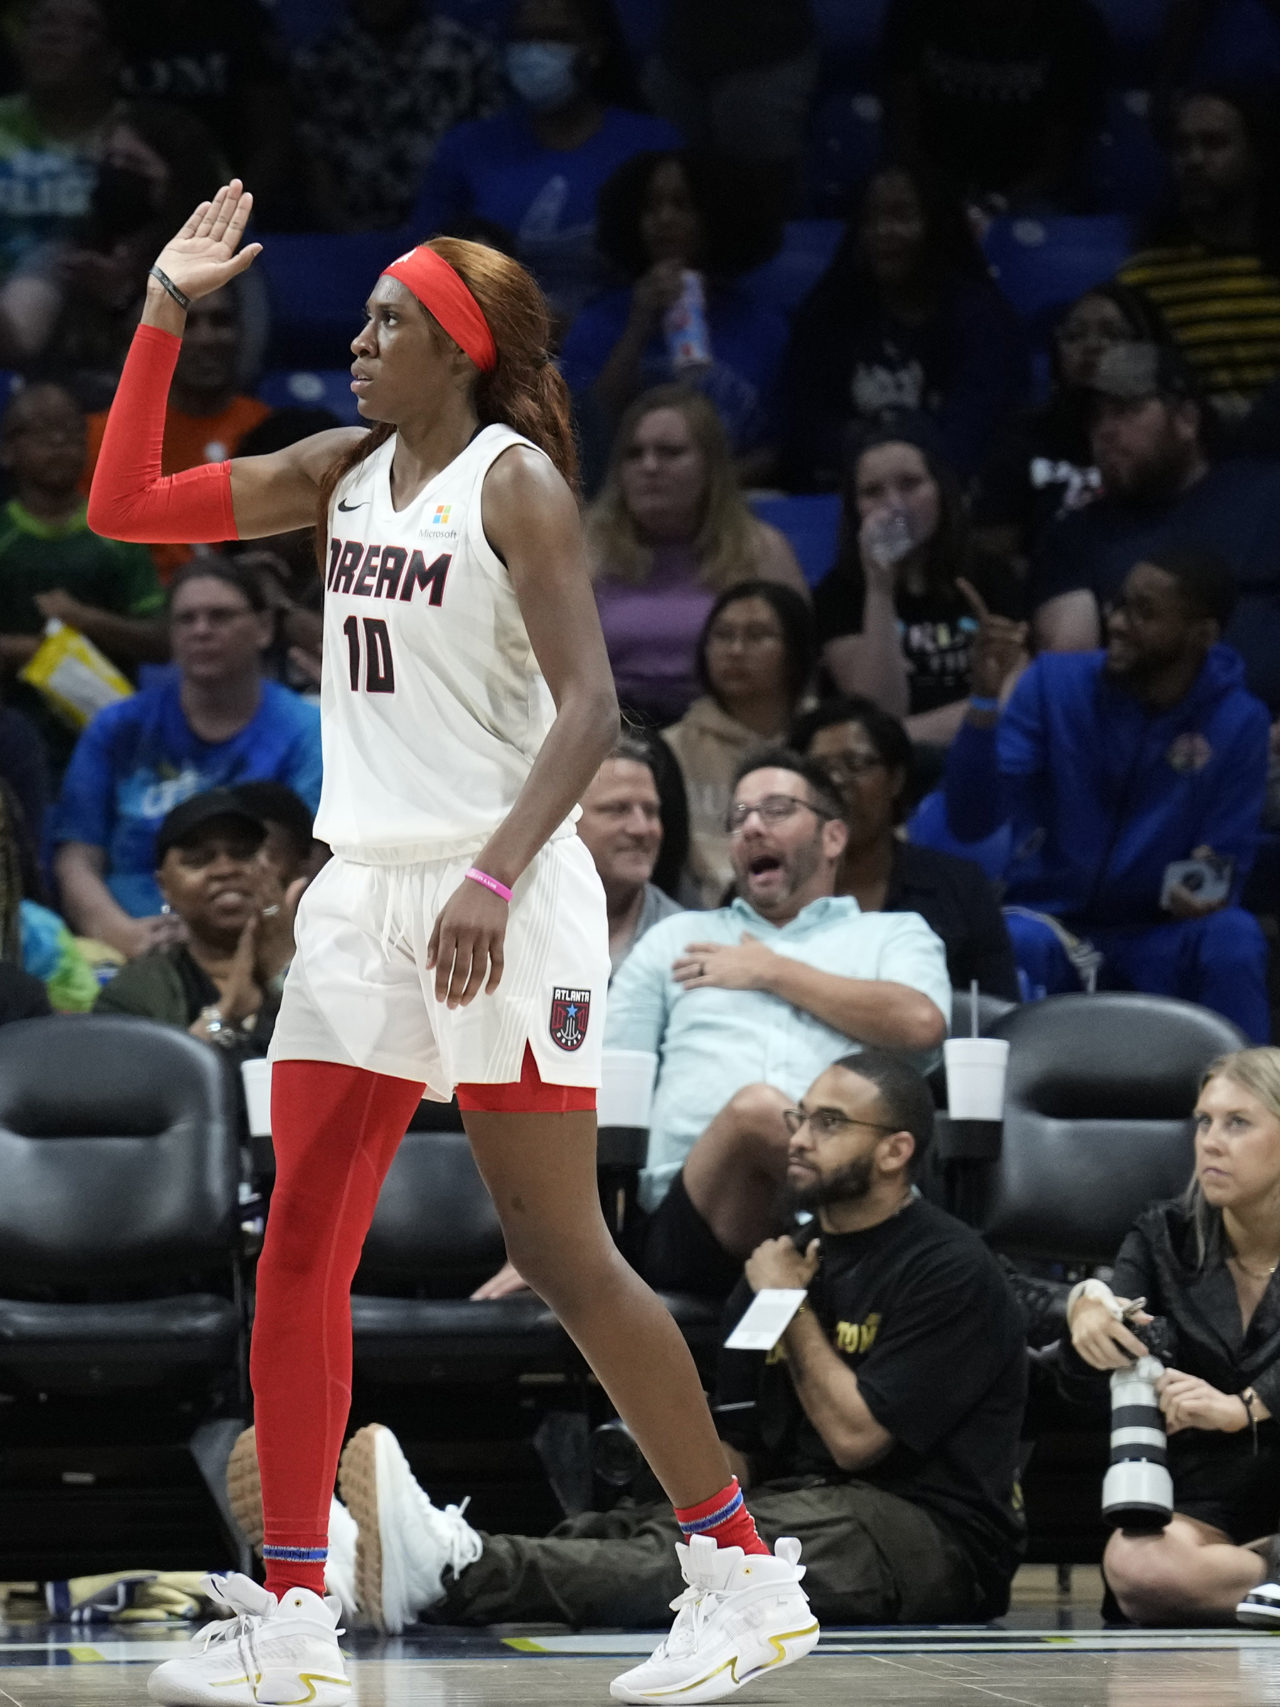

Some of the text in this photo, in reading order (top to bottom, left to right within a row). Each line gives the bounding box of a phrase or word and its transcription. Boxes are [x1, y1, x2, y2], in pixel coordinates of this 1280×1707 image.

[419, 528, 458, 540] Microsoft
[344, 615, 395, 694] 10
[555, 989, 589, 1002] ATLANTA
